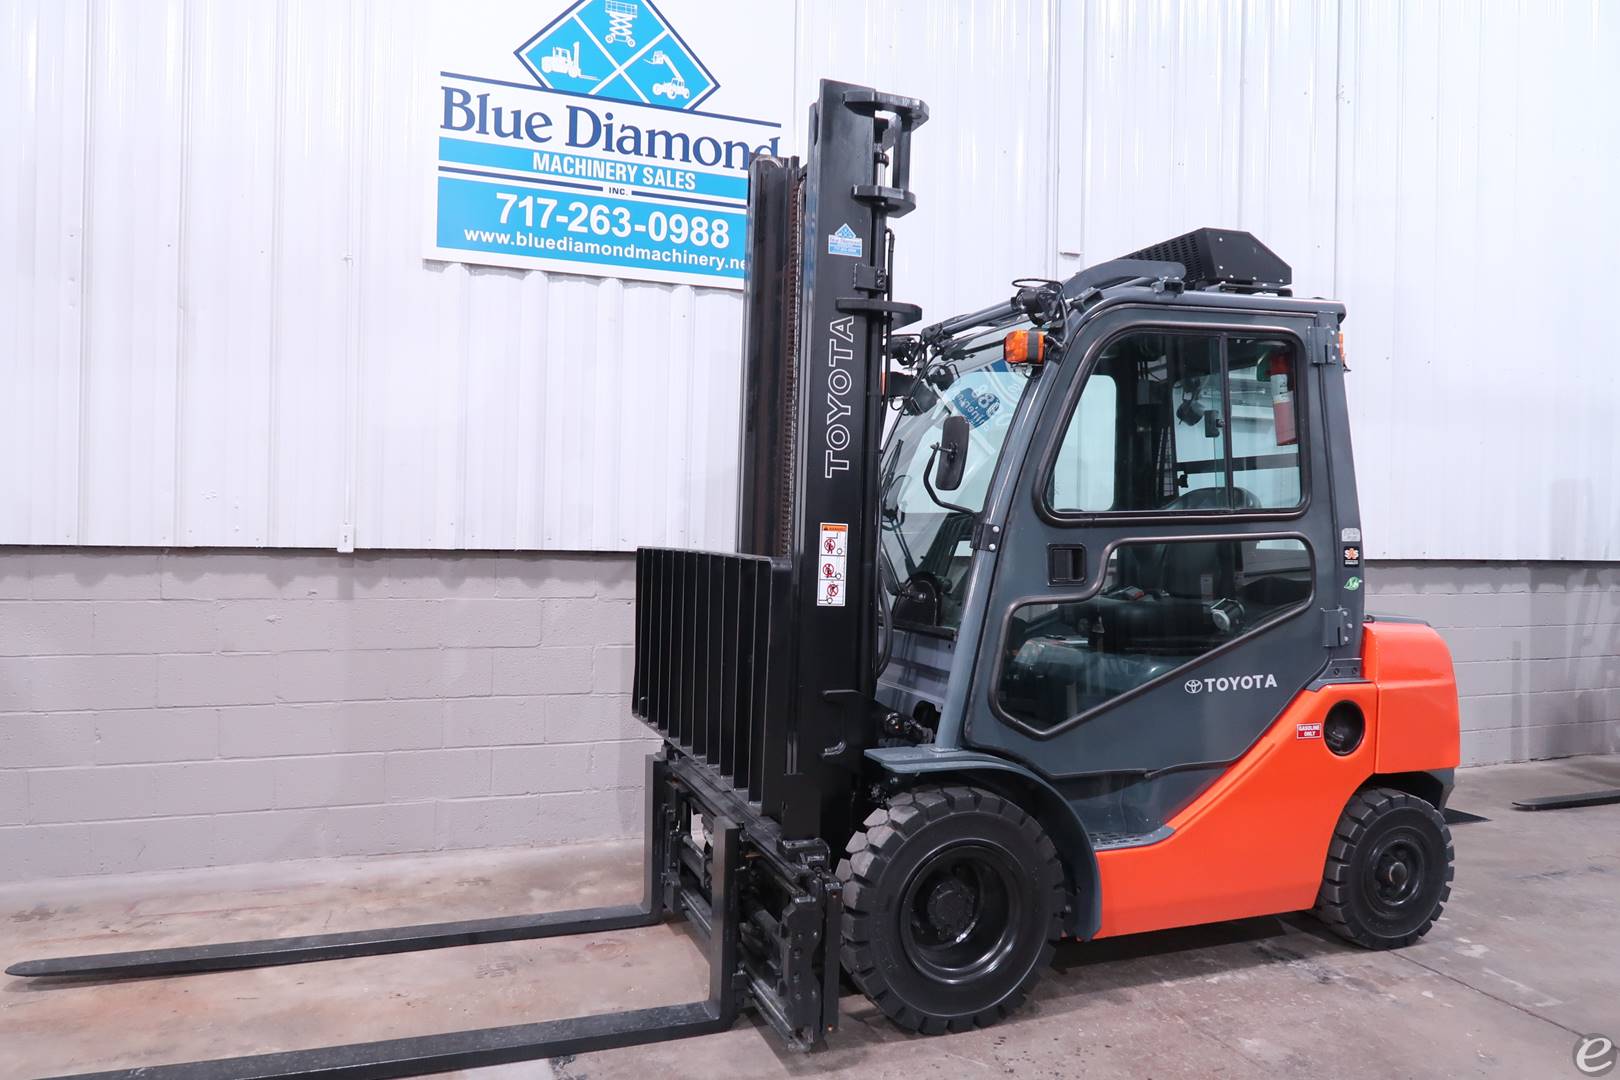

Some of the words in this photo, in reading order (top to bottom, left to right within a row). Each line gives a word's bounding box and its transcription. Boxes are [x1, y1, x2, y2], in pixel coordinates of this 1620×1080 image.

[440, 86, 553, 144] Blue
[532, 152, 638, 184] MACHINERY
[642, 167, 696, 191] SALES
[608, 186, 629, 197] INC.
[496, 192, 730, 249] 717-263-0988
[825, 315, 854, 479] TOYOTA
[1204, 673, 1278, 693] TOYOTA
